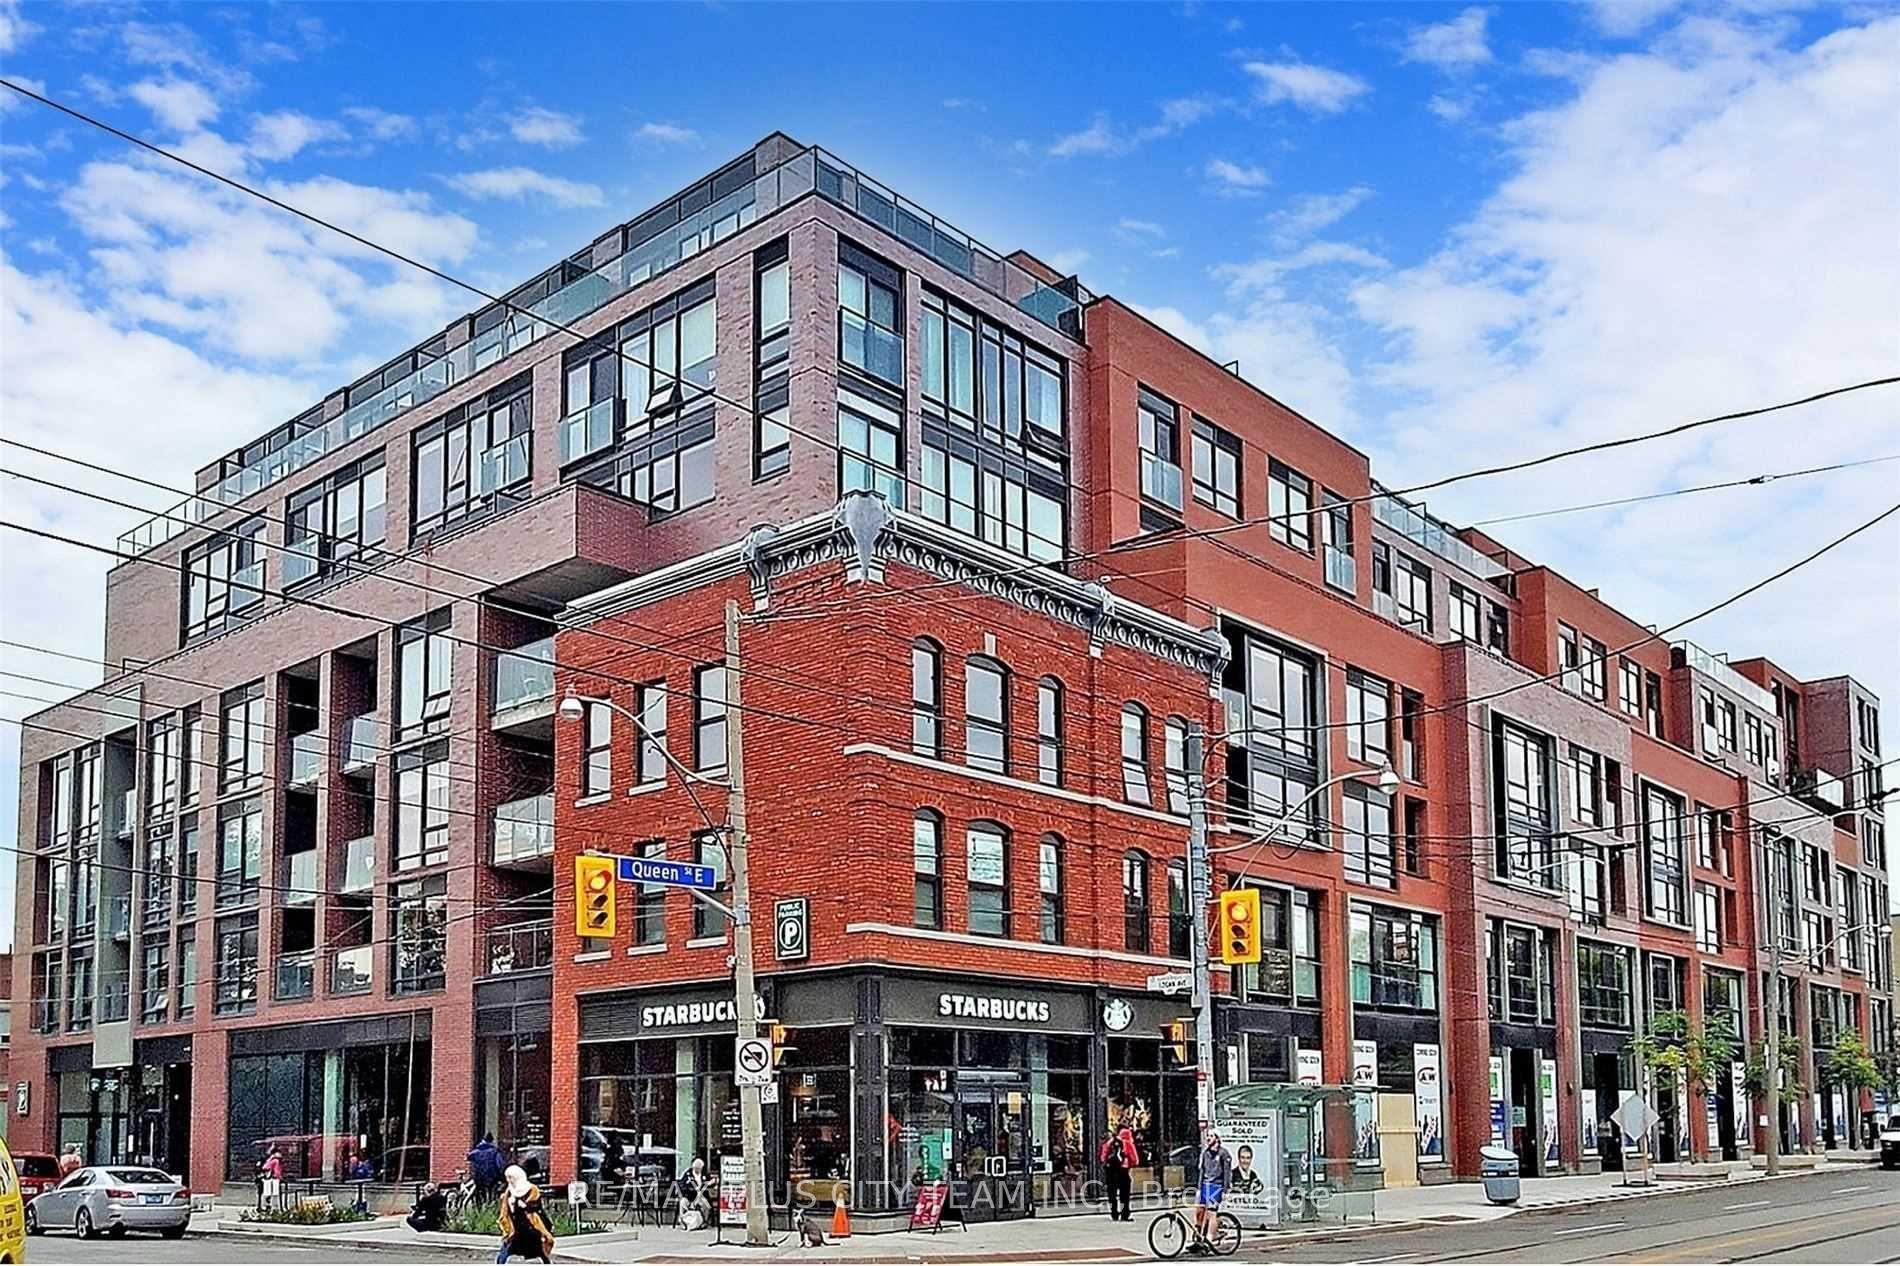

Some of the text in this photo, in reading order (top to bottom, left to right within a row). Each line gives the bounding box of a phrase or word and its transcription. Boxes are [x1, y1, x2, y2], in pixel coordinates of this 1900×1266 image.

[631, 861, 679, 881] Queen
[694, 868, 704, 883] E
[784, 921, 798, 945] P
[642, 1000, 738, 1027] STARBUCK
[939, 993, 1050, 1022] STARBUCKS
